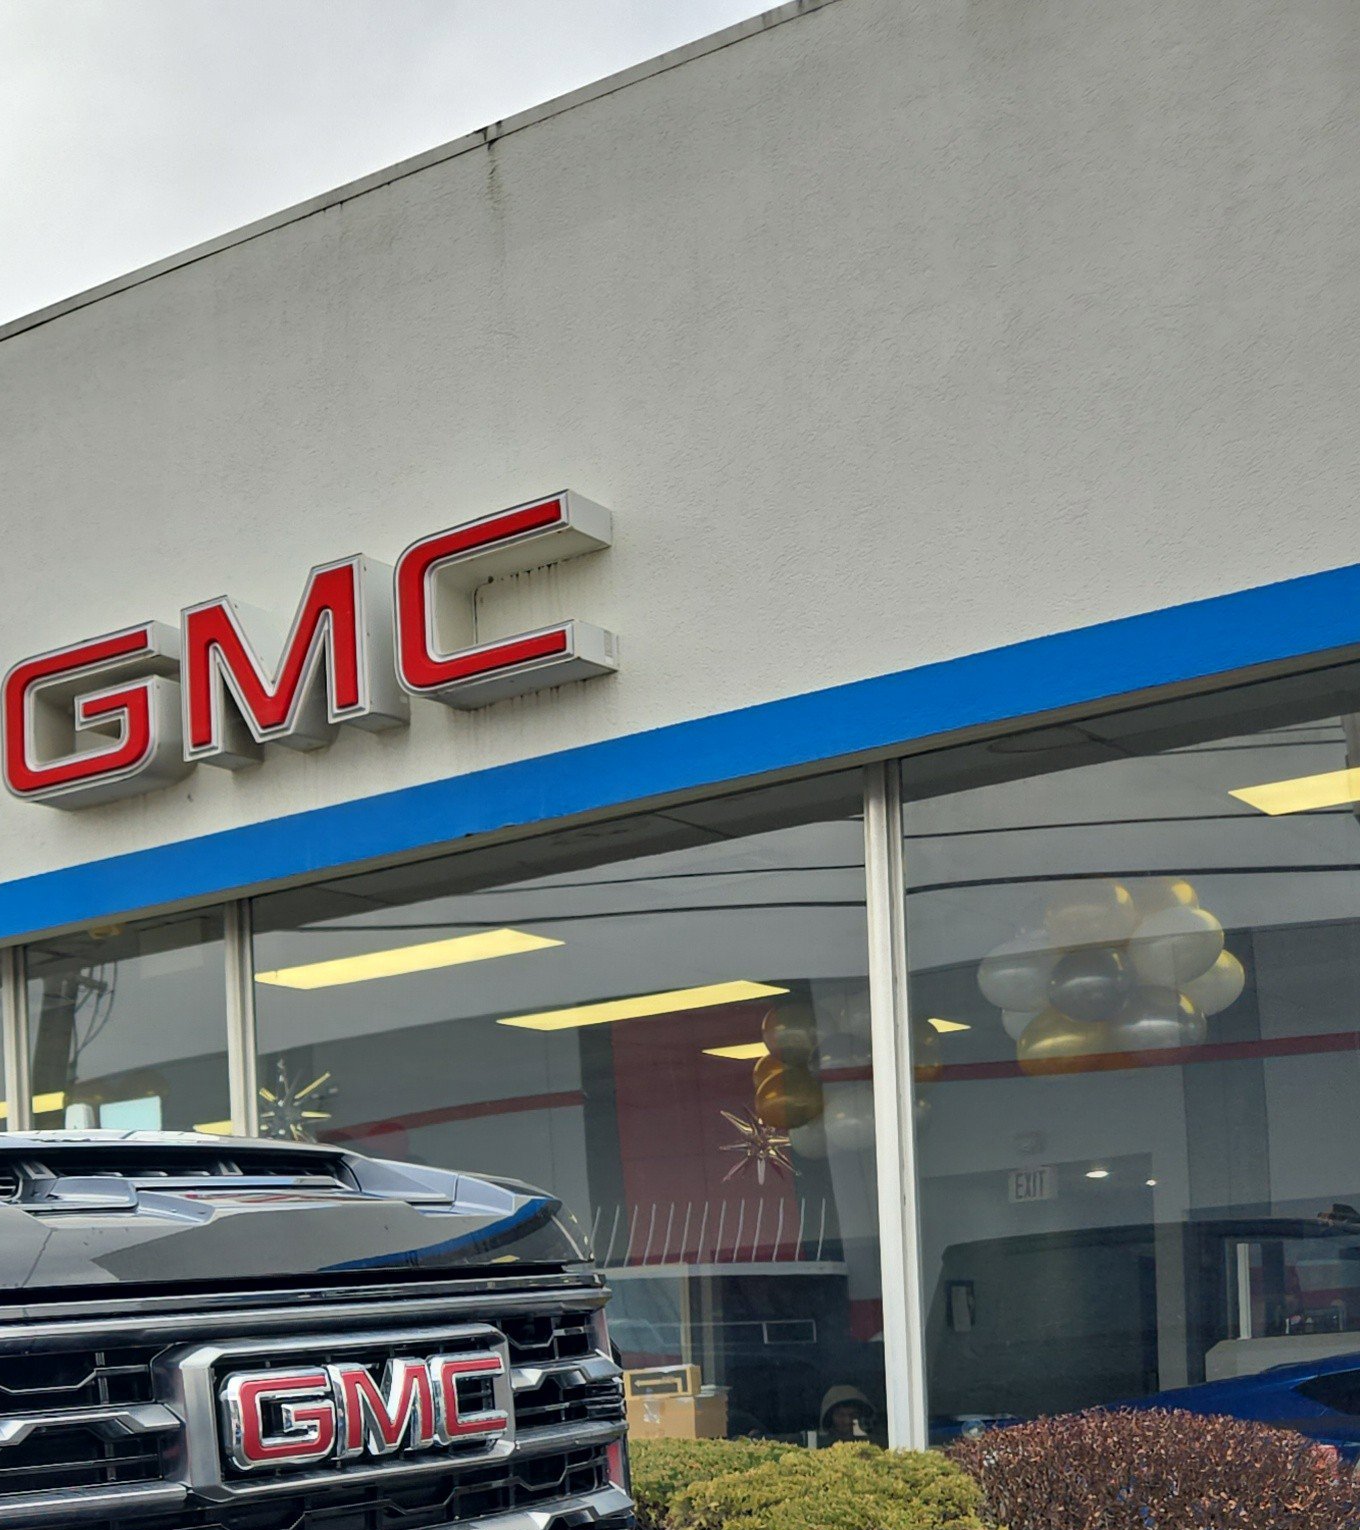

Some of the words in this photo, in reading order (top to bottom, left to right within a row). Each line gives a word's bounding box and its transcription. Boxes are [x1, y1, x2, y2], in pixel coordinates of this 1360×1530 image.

[1, 490, 592, 803] GMC
[1015, 1169, 1046, 1199] EXIT
[220, 1350, 509, 1470] GMC
